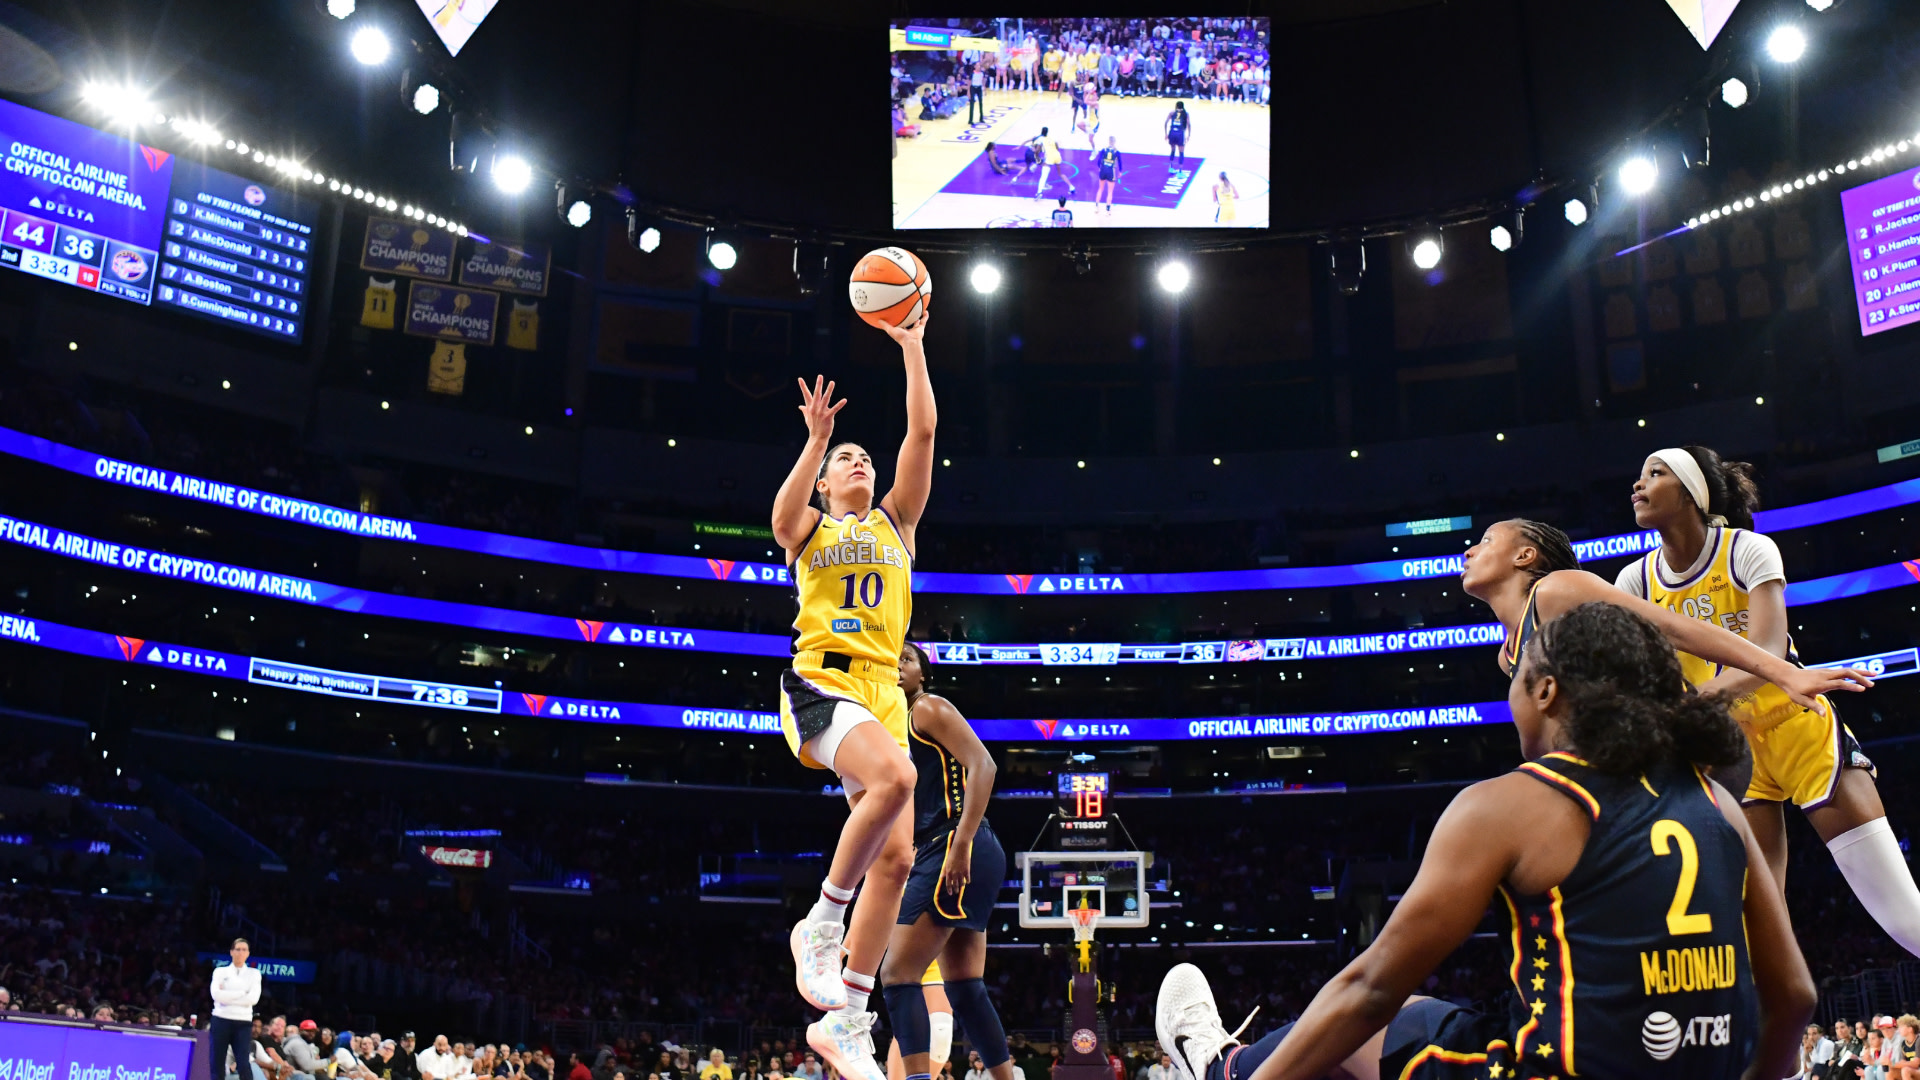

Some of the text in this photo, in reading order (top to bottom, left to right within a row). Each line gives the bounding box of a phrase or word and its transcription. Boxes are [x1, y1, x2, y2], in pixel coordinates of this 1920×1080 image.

[11, 141, 128, 189] OFFICIAL AIRLINE
[5, 156, 146, 211] CRYPTO.COM ARENA.
[45, 200, 94, 223] DELTA
[179, 202, 307, 251] 0 K.Mitchell 10 1 2 2
[1859, 227, 1868, 240] 2
[13, 221, 94, 260] 44 36
[175, 223, 304, 271] 2 A.McDonald 2 3 1 0
[368, 246, 447, 268] CHAMPIONS
[1863, 248, 1872, 260] 5
[29, 255, 70, 278] 3:34
[172, 244, 181, 257] 6
[188, 249, 238, 274] N.Howard
[269, 273, 277, 285] 3
[282, 277, 288, 289] 1
[294, 281, 300, 292] 1
[424, 264, 445, 276] 2001
[467, 261, 542, 283] CHAMPIONS
[1863, 259, 1917, 282] 10 K.Plum
[169, 265, 178, 279] 7
[184, 272, 232, 295] A.Boston
[278, 298, 286, 310] 2
[290, 302, 298, 313] 0
[1866, 289, 1881, 304] 20
[164, 287, 173, 301] 8
[263, 316, 271, 327] 0
[275, 319, 283, 331] 2
[287, 322, 295, 334] 0
[412, 310, 489, 331] CHAMPIONS
[1869, 310, 1885, 325] 23
[467, 329, 488, 339] 2016
[95, 457, 417, 541] OFFICIAL AIRLINE OF CRYPTO.COM ARENA.
[838, 524, 878, 544] LOS
[1406, 517, 1450, 529] AMERICAN
[1412, 525, 1452, 536] EXPRESS
[53, 532, 120, 565] AIRLINE
[122, 547, 147, 570] OF
[148, 552, 256, 592] CRYPTO.COM
[258, 576, 317, 602] ARENA.
[808, 543, 904, 573] ANGELES
[1402, 556, 1464, 577] OFFICIAL
[839, 571, 884, 610] 10
[1060, 577, 1124, 592] DELTA
[1708, 582, 1730, 594] Albert
[835, 620, 858, 631] UCLA
[630, 627, 696, 647] DELTA
[1327, 634, 1386, 655] AIRLINE
[1386, 632, 1407, 651] OF
[1408, 625, 1504, 650] CRYPTO.COM
[168, 649, 227, 672] DELTA
[946, 645, 1216, 663] 44 Sparks 3:34 2 Fever 36
[1272, 647, 1280, 658] 1
[1290, 647, 1300, 657] 4
[261, 666, 369, 694] Happy 20th Birthday,
[411, 684, 469, 707] 7:36
[566, 704, 622, 720] DELTA
[682, 709, 747, 731] OFFICIAL
[1188, 706, 1482, 737] OFFICIAL AIRLINE OF CRYPTO.COM ARENA.
[1078, 724, 1130, 736] DELTA
[1071, 775, 1106, 792] 3:34
[1076, 791, 1102, 818] 18
[1073, 821, 1108, 829] TISSOT
[1650, 819, 1712, 936] 2
[257, 963, 296, 977] ULTRA
[1640, 944, 1736, 996] McDONALD
[1682, 1013, 1731, 1048] AT&T
[13, 1058, 55, 1080] Albert
[68, 1061, 111, 1080] Budget
[116, 1064, 151, 1080] Spend
